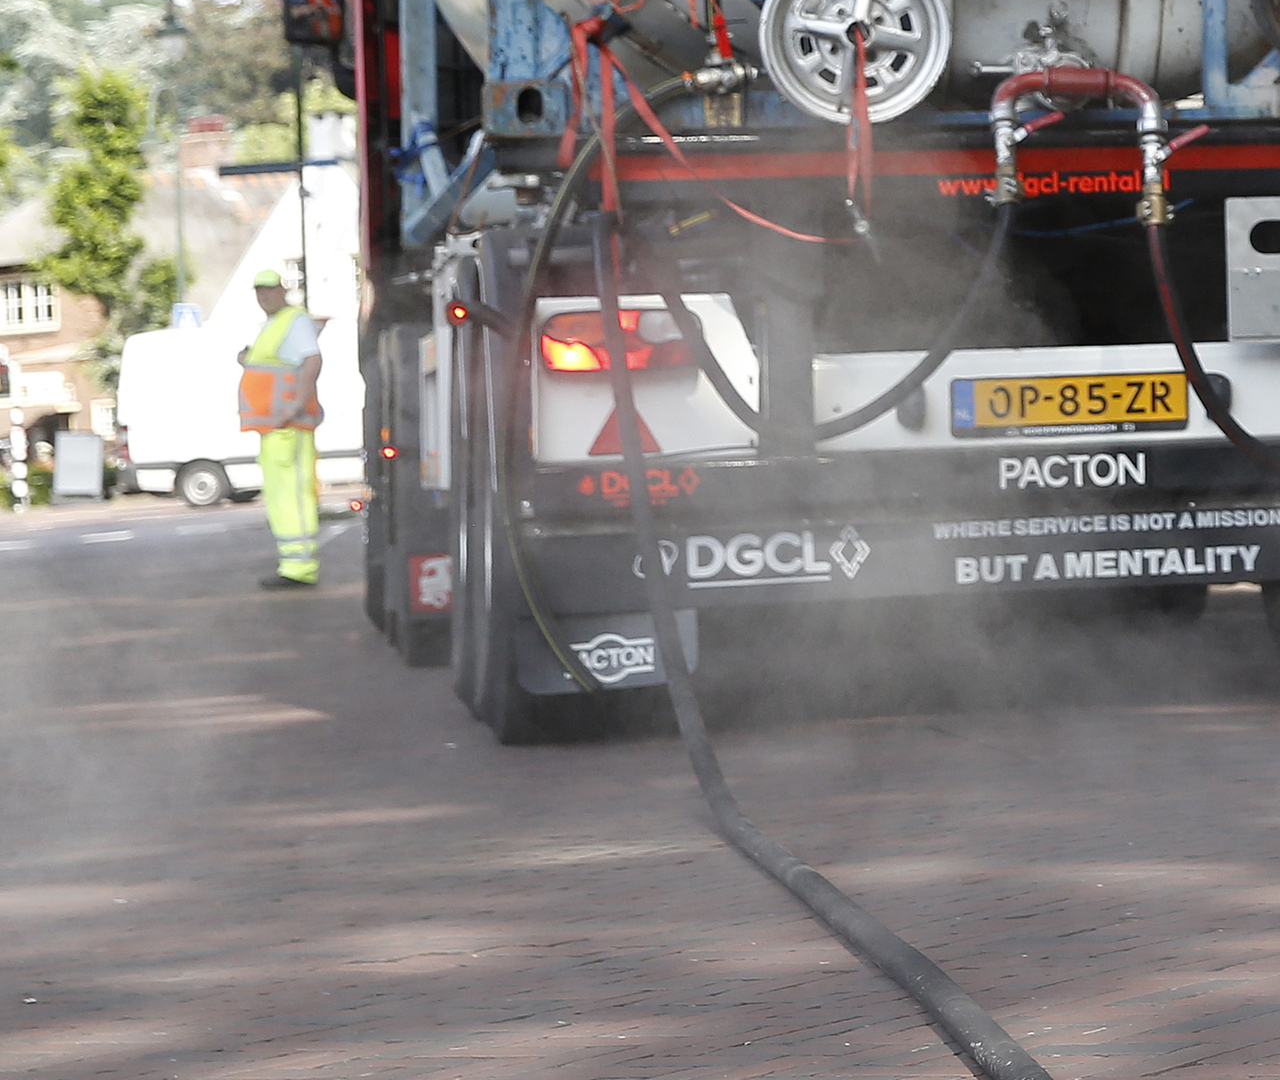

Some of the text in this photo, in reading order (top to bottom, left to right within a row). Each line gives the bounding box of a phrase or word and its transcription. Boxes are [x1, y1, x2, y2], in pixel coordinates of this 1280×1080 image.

[989, 380, 1172, 418] OP-85-ZR
[998, 452, 1147, 490] PACTON
[934, 520, 1011, 540] WHERE
[1012, 515, 1108, 537] SERVICE
[1110, 513, 1131, 532] IS
[1133, 511, 1176, 532] NOT
[1177, 511, 1196, 530] A
[685, 530, 832, 579] DGCL
[955, 544, 1261, 585] BUT A MENTALITY
